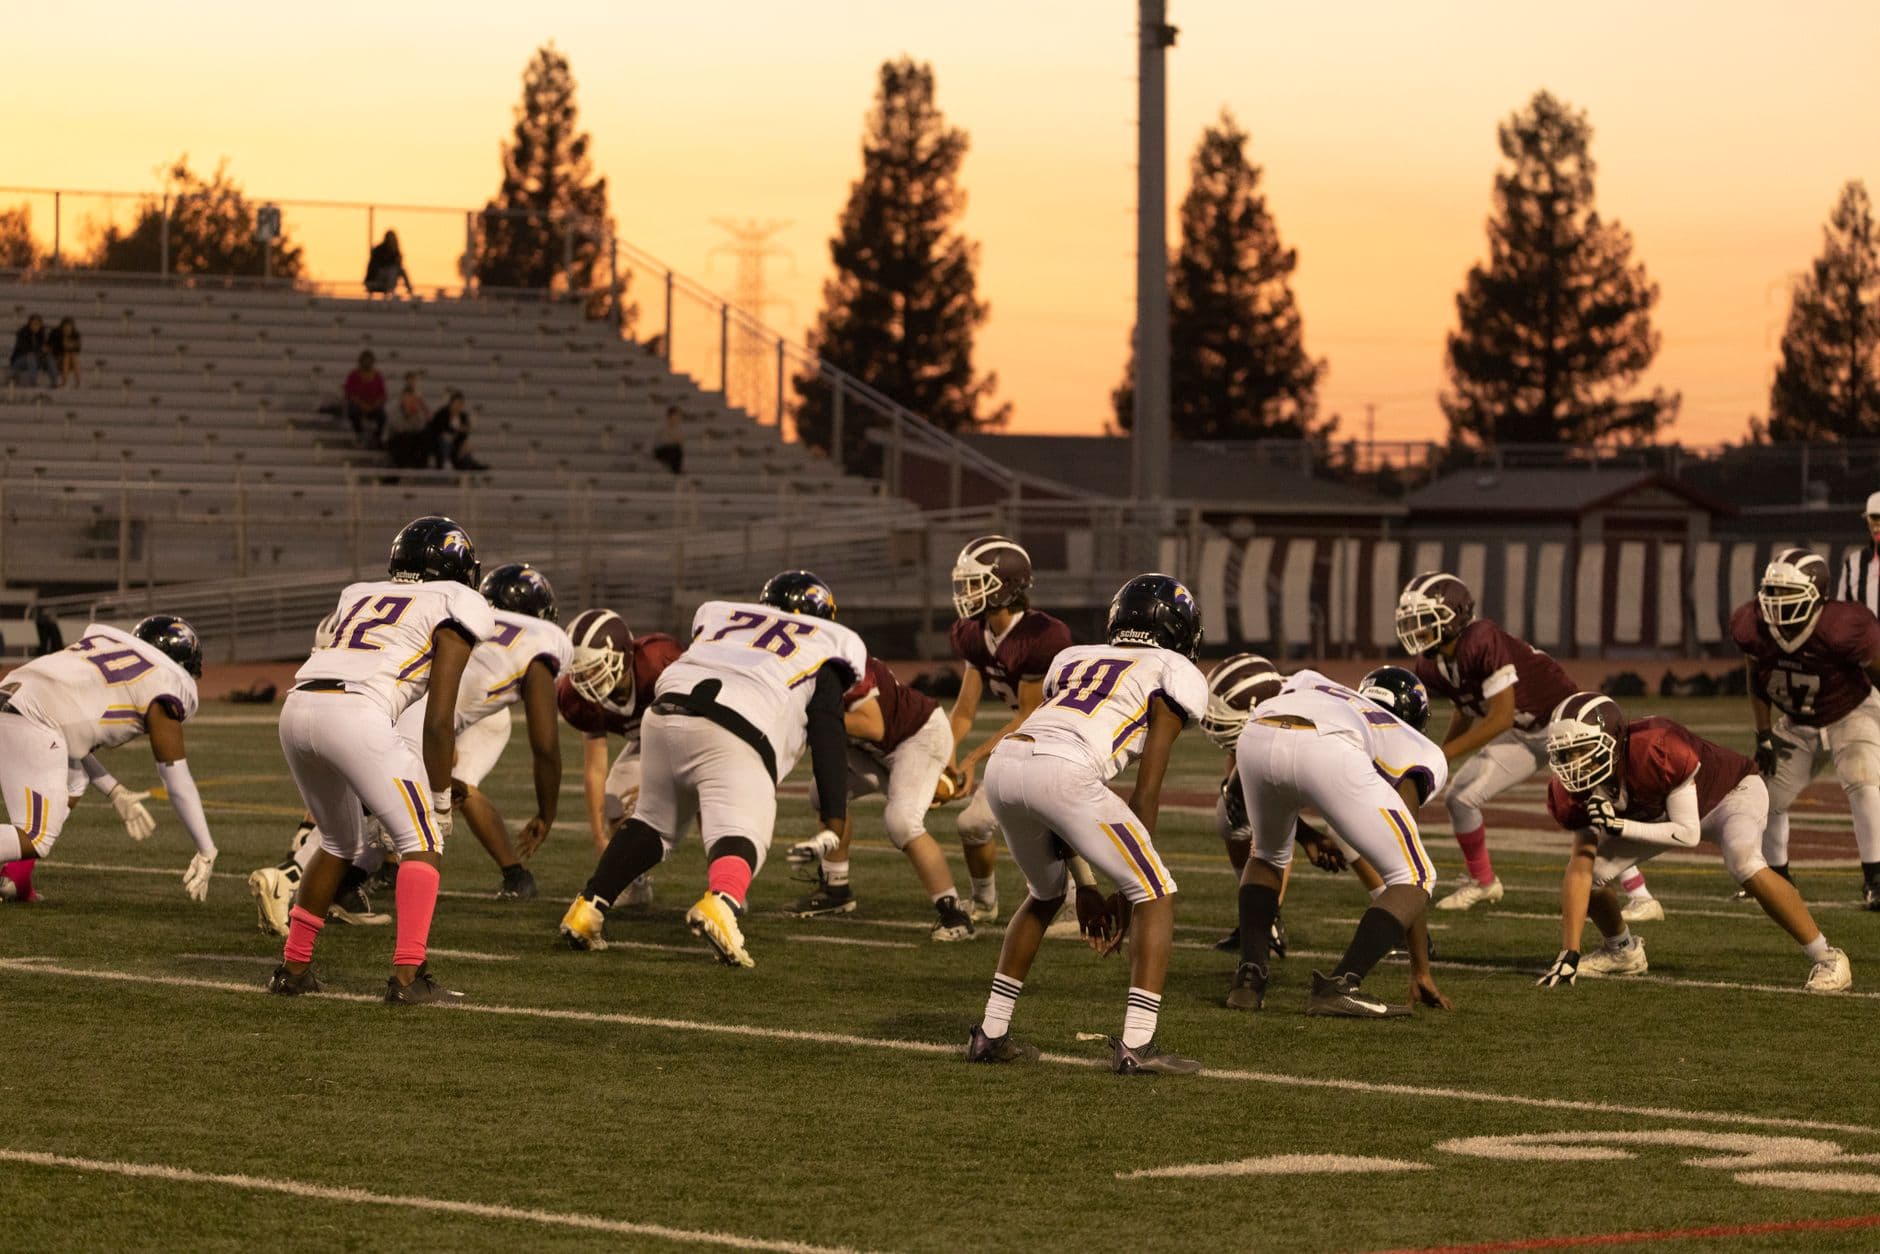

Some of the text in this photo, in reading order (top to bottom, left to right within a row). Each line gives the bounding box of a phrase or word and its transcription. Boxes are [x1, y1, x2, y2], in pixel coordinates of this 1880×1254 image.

[330, 595, 416, 652] 12
[706, 610, 818, 660] 76
[1119, 628, 1150, 639] schutt
[1056, 657, 1138, 718] 10
[1767, 669, 1821, 716] 47
